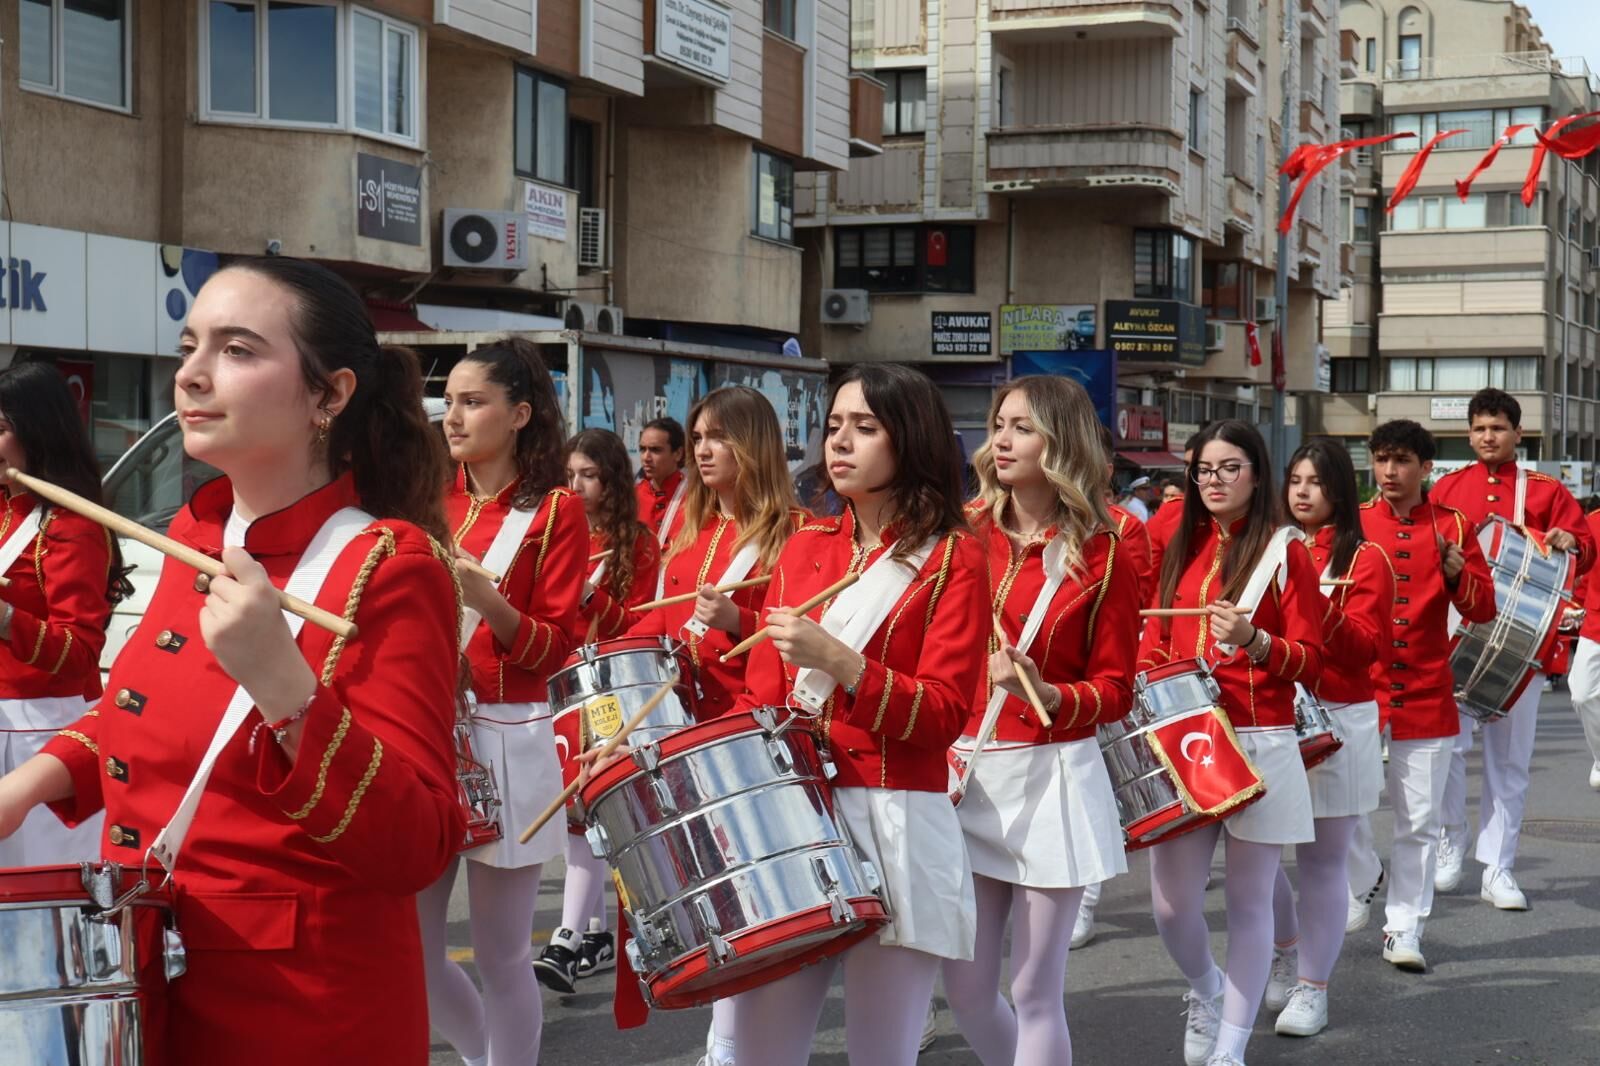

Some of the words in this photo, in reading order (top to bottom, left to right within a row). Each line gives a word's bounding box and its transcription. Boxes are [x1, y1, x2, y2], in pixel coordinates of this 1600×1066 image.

[528, 188, 563, 208] AKIN
[506, 222, 516, 260] VESTEL
[1129, 308, 1160, 317] AVUKAT
[948, 316, 990, 328] AVUKAT
[1113, 322, 1146, 331] ALEYNA
[1147, 321, 1176, 332] ÖZCAN
[591, 702, 616, 718] MTK
